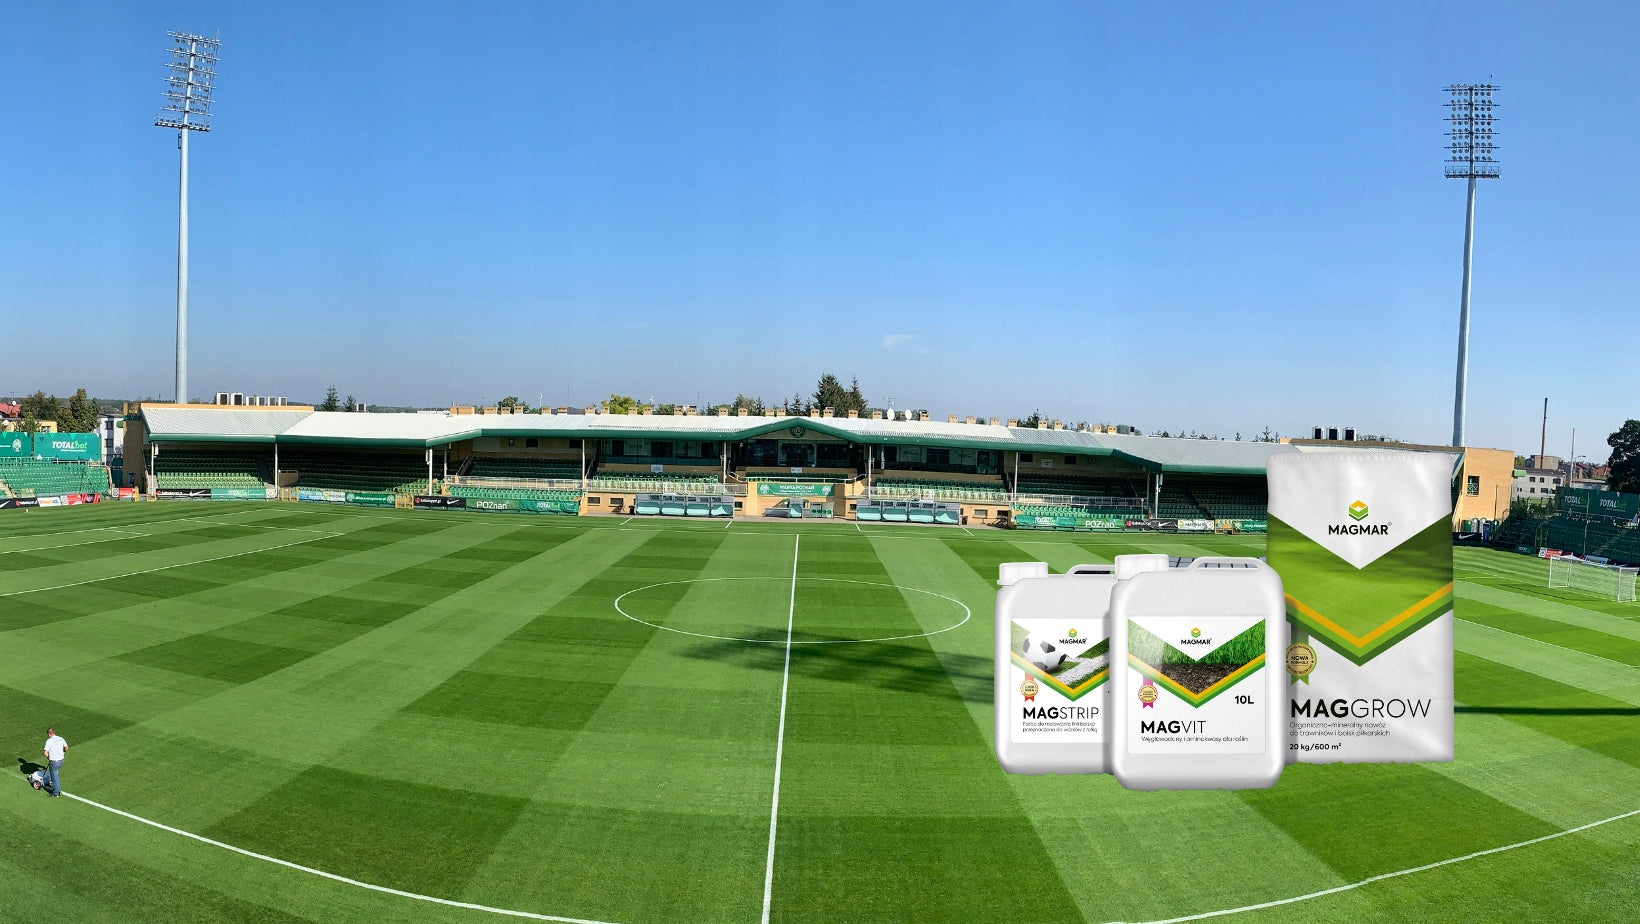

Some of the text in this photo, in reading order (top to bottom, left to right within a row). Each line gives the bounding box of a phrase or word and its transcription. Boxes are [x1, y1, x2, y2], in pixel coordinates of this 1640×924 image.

[52, 441, 88, 450] TOTALbet
[1328, 524, 1389, 536] MAGMAR
[1234, 695, 1255, 705] 10L
[1022, 706, 1100, 720] MAGSTRIP
[1290, 698, 1432, 719] MAGGROW
[1140, 720, 1207, 734] MAGVIT
[1300, 743, 1330, 751] kg/600
